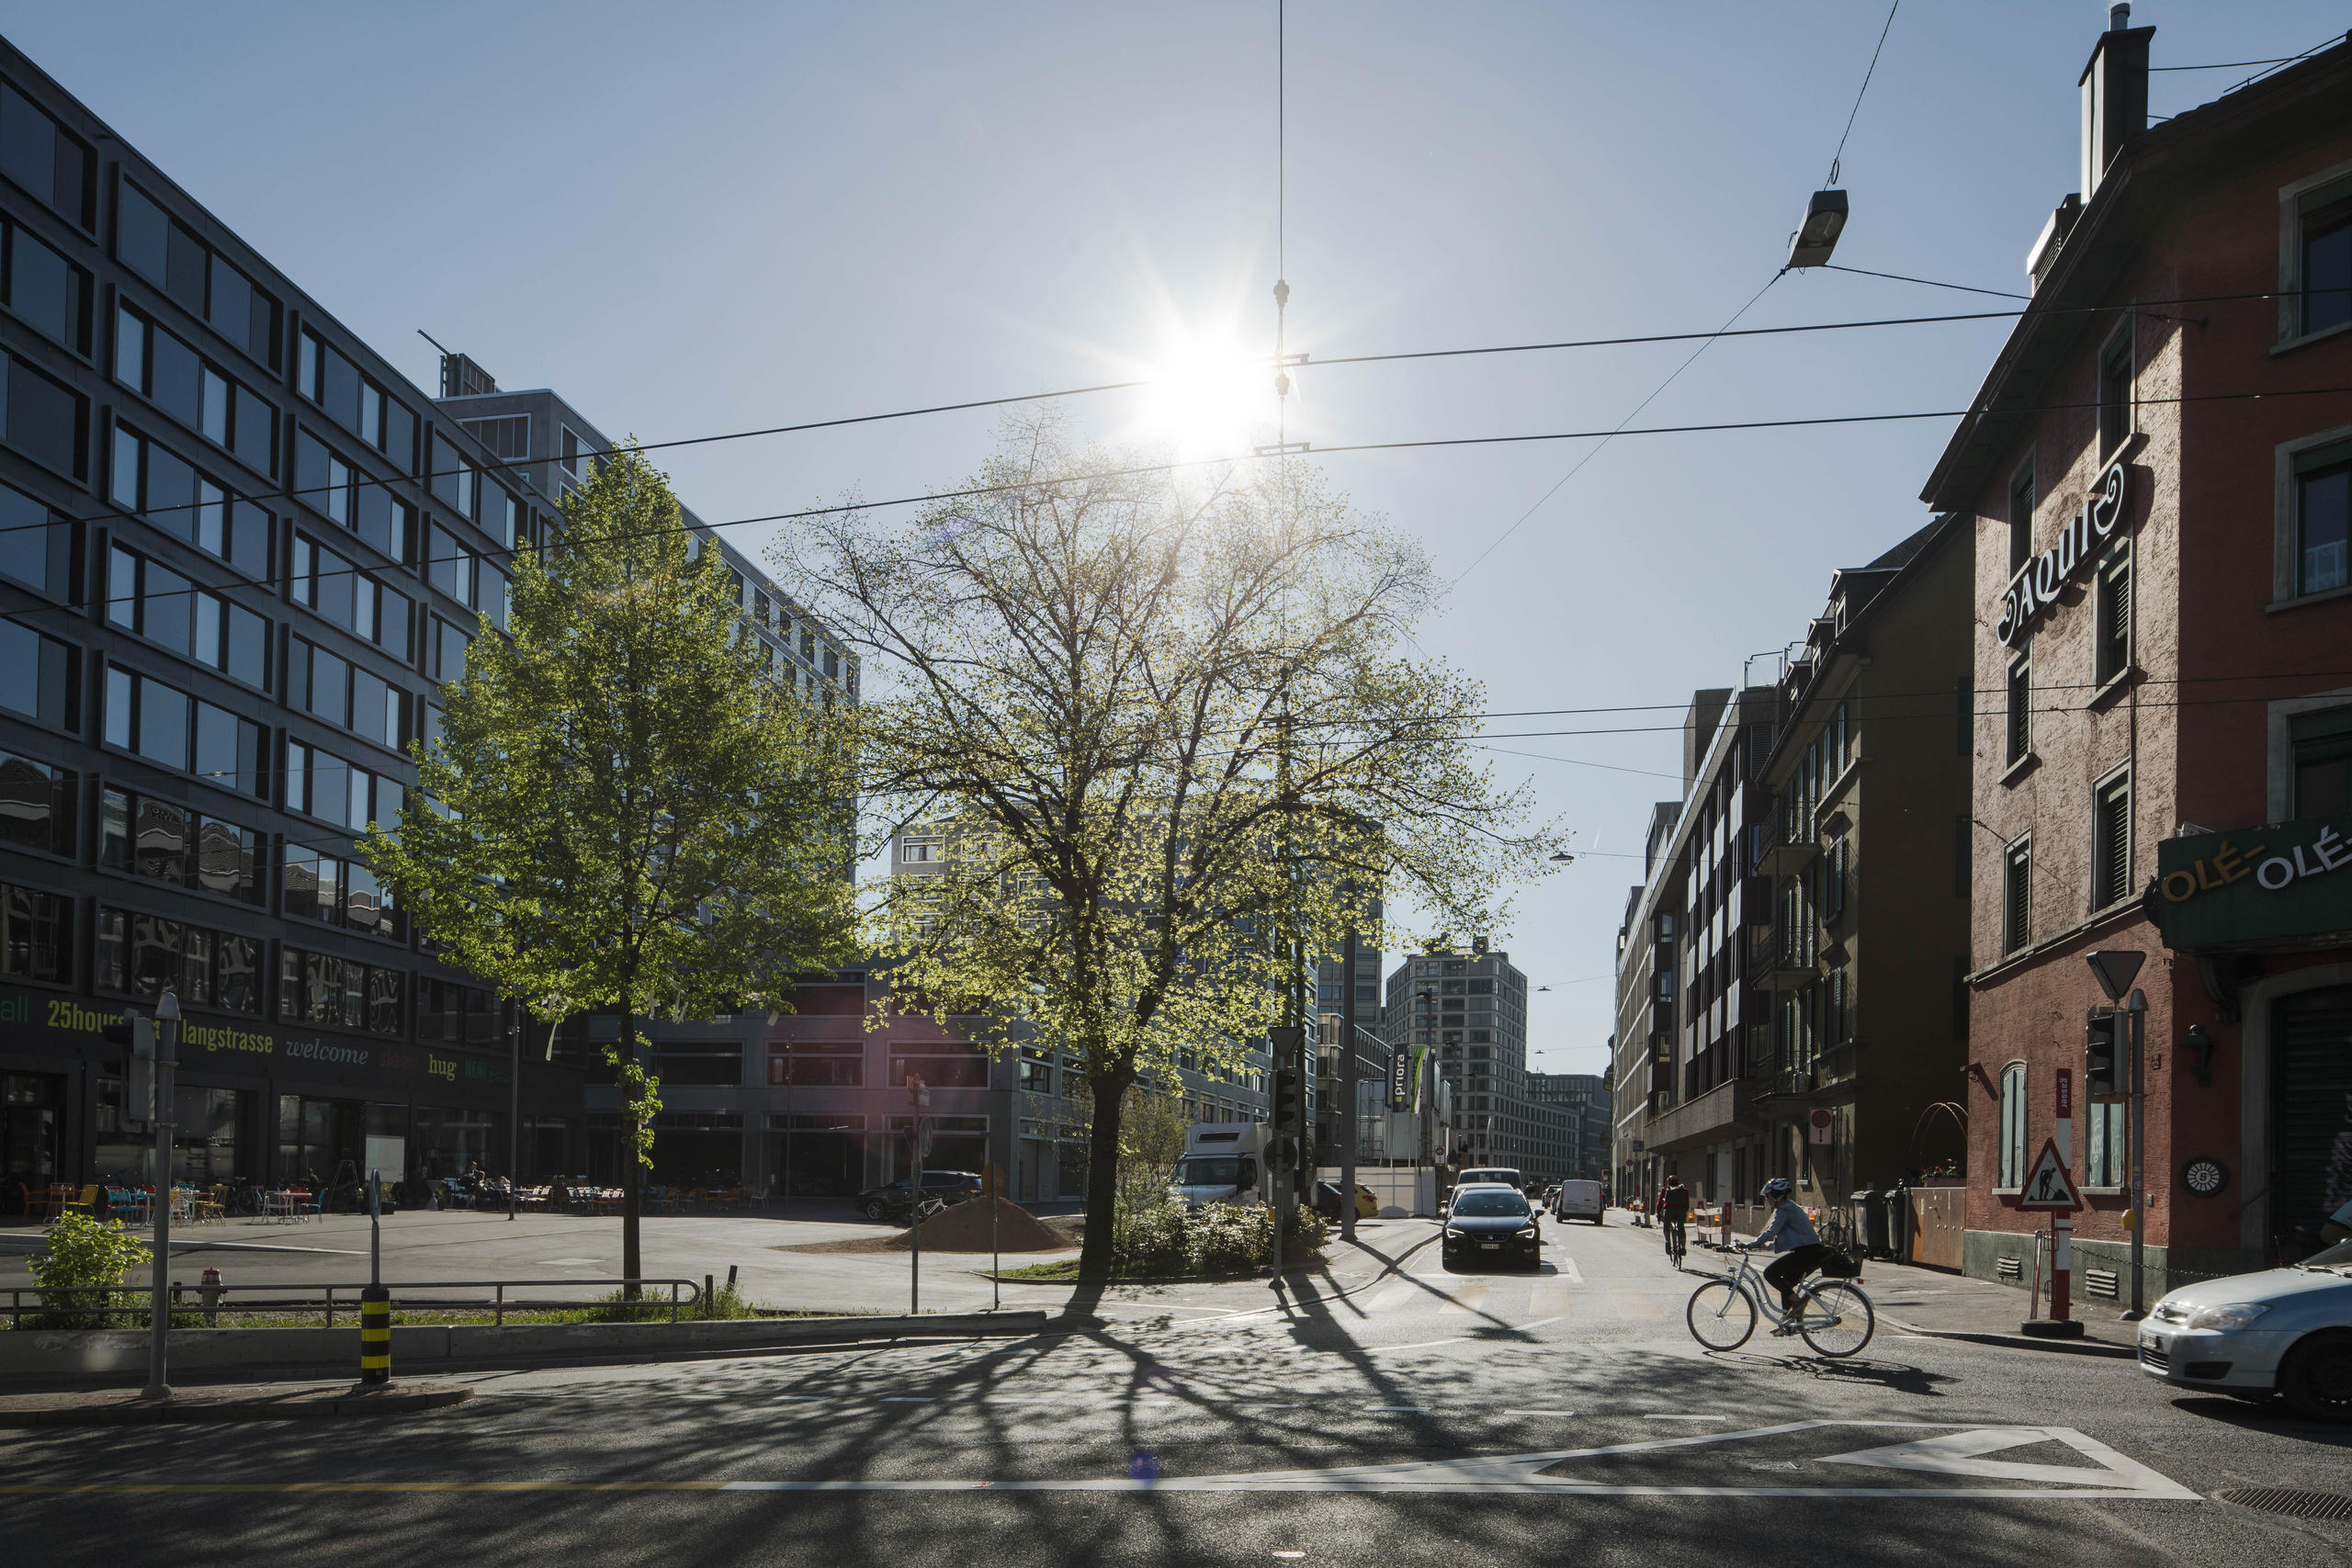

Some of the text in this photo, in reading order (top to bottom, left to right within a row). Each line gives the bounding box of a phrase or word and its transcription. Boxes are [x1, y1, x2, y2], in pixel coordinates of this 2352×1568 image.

[2017, 499, 2101, 629] AQUI
[183, 1018, 273, 1054] langstrasse
[287, 1038, 368, 1065] welcome
[428, 1053, 457, 1081] hug
[1395, 1054, 1406, 1095] priora
